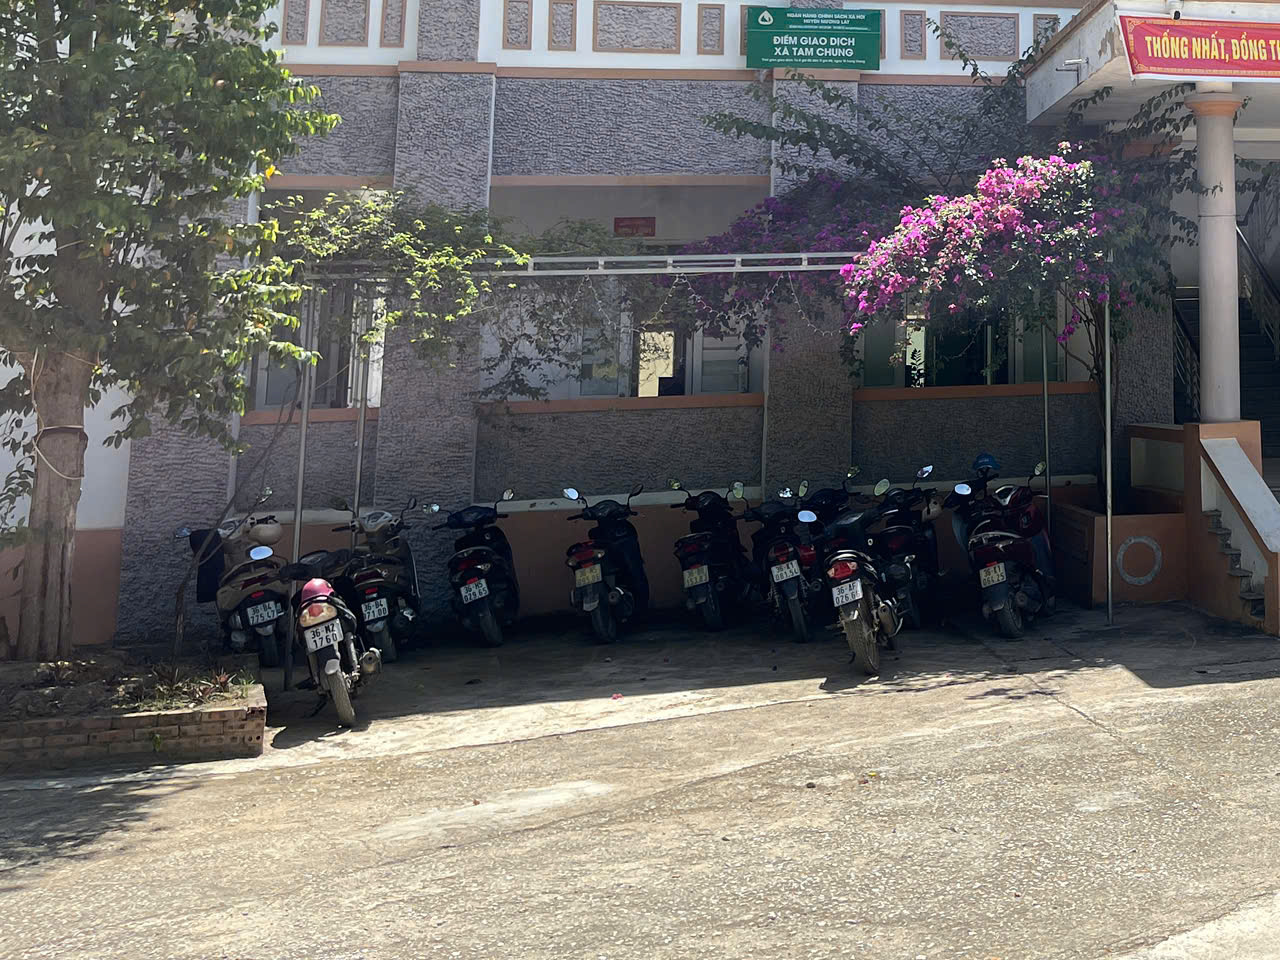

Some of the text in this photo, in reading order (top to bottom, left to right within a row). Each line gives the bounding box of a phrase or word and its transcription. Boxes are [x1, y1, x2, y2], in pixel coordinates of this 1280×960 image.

[800, 36, 827, 46] GIAO
[829, 37, 855, 47] DỊCH
[1144, 29, 1189, 59] THỐNG
[1191, 31, 1230, 62] NHẤT,
[1231, 31, 1268, 61] ĐỒNG
[792, 47, 814, 56] TAM
[816, 48, 854, 57] CHUNG
[836, 582, 856, 595] 36-AF
[251, 604, 272, 615] 36-B4
[313, 633, 338, 649] 1760
